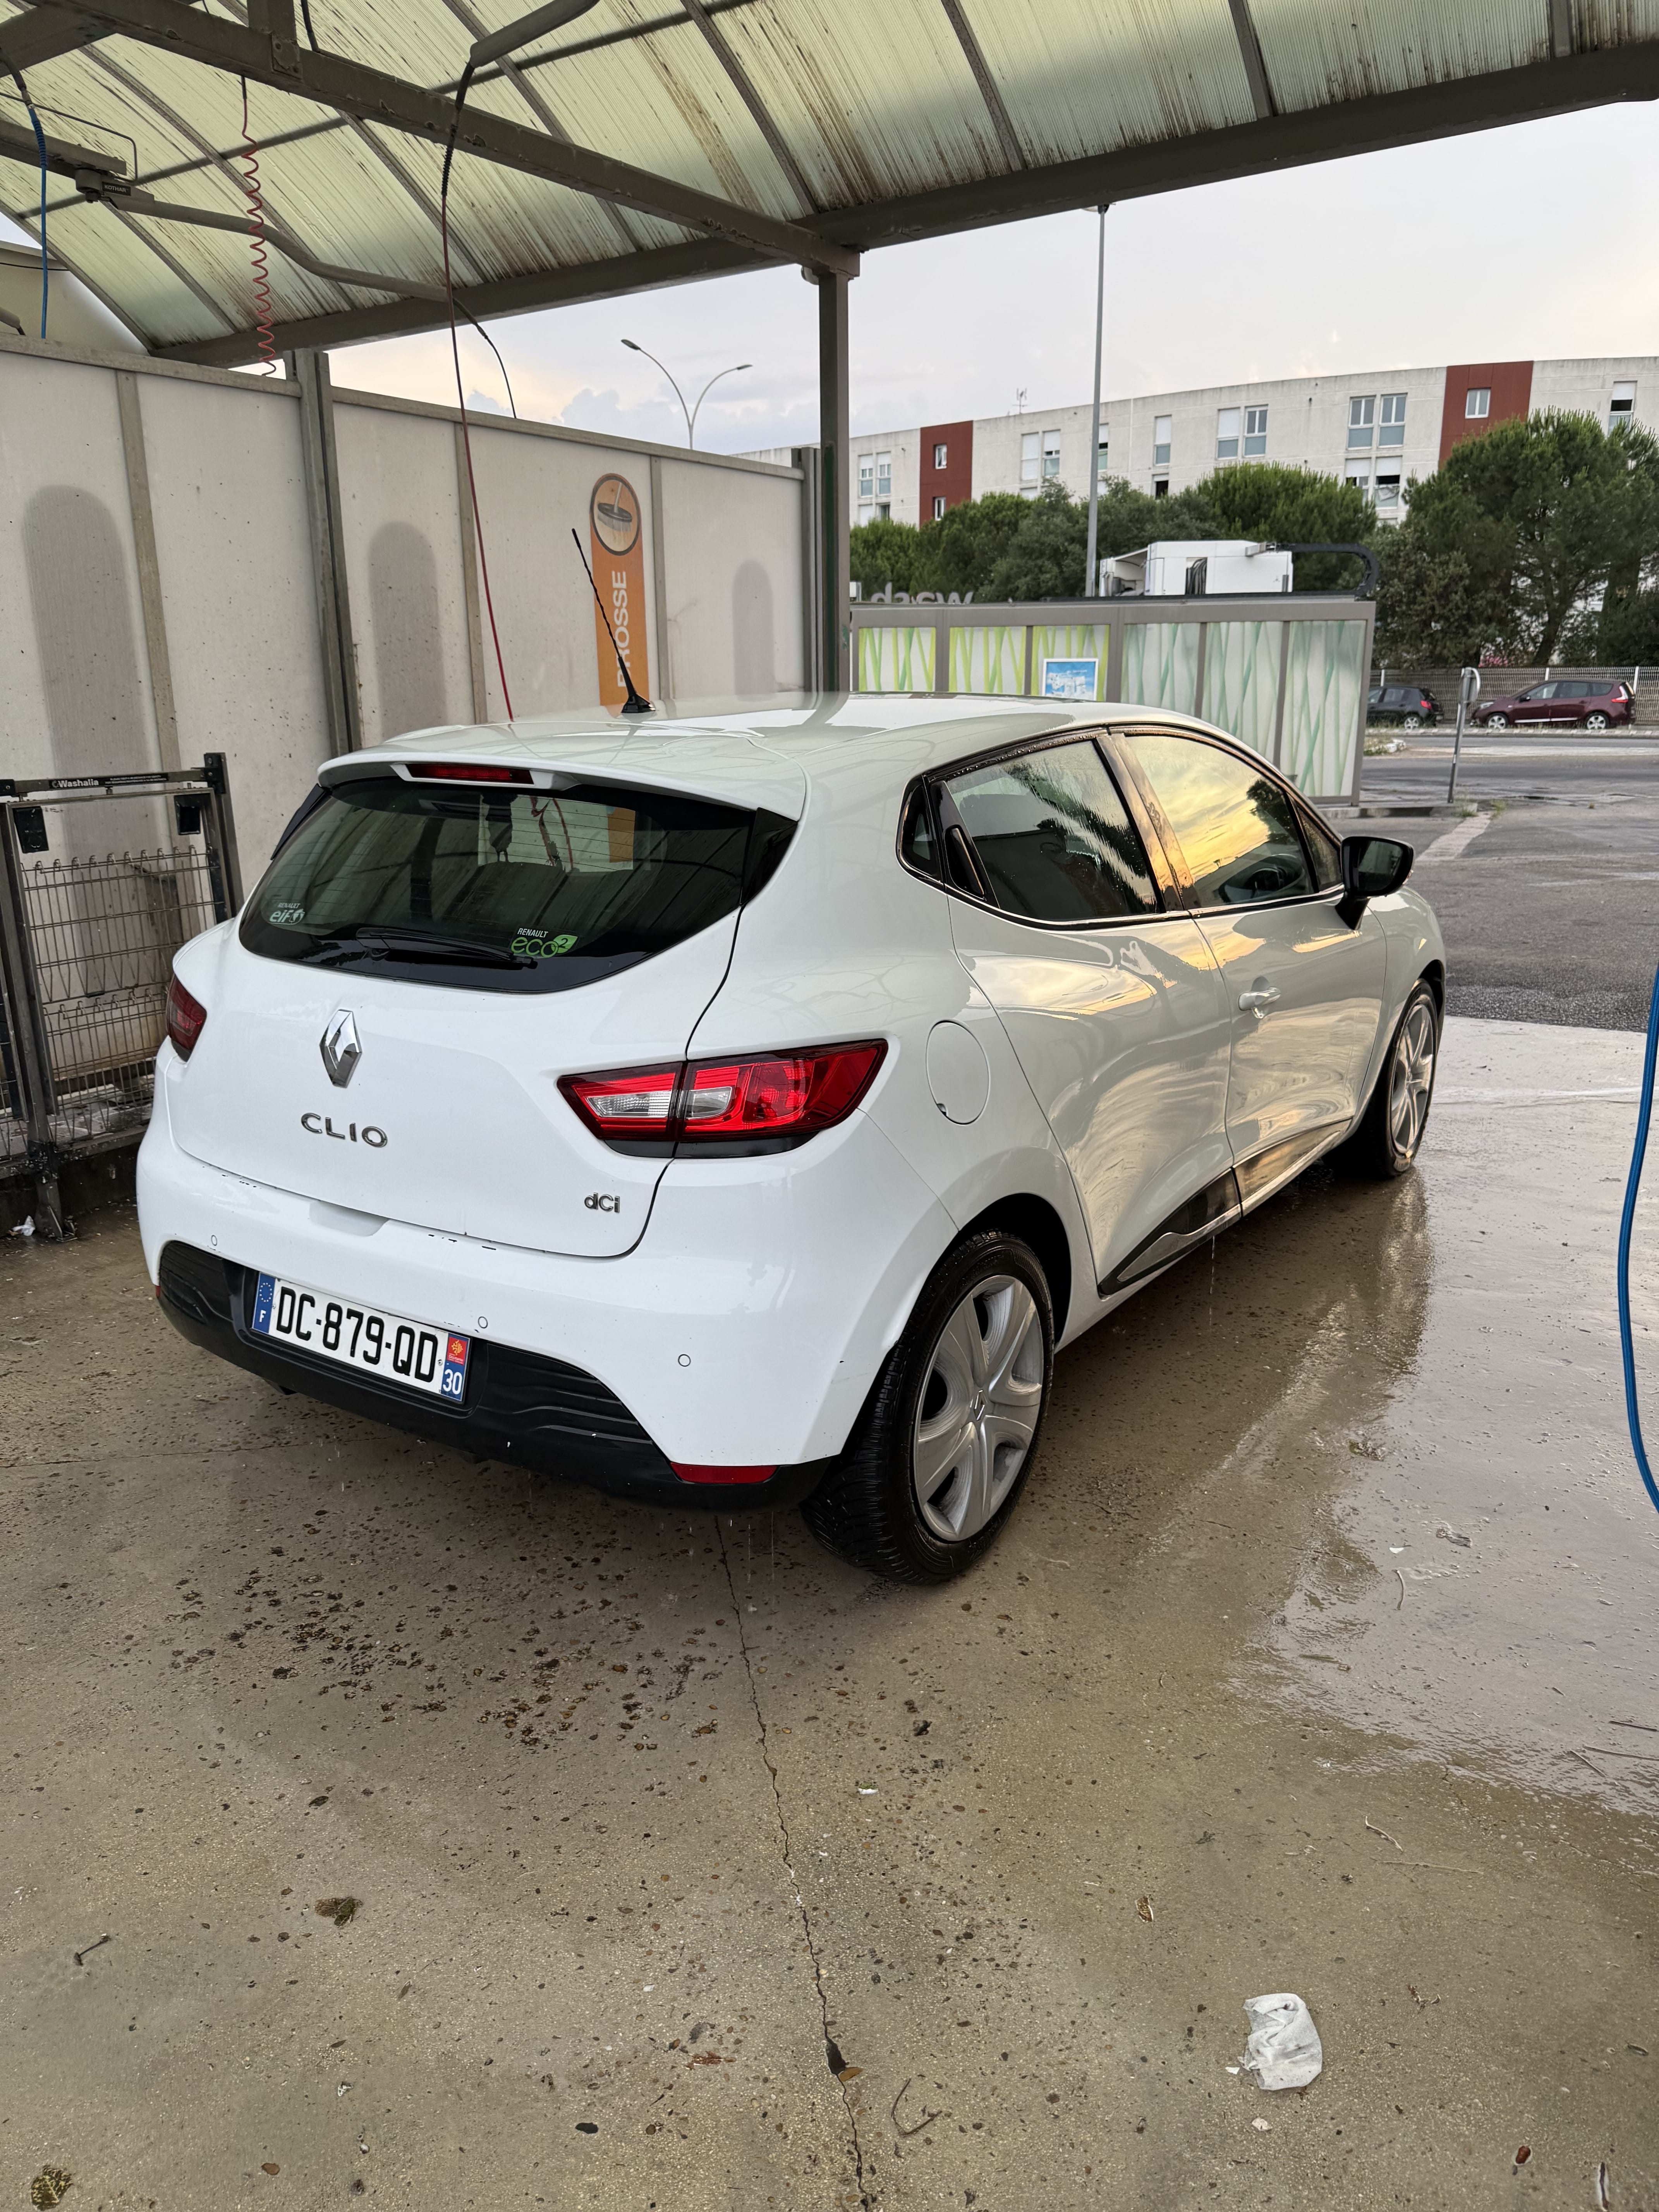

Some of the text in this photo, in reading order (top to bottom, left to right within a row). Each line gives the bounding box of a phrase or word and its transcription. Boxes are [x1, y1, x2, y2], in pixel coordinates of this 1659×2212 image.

[58, 778, 99, 788] Washalia
[517, 927, 549, 938] RENAULT
[301, 1112, 388, 1148] CLIO
[259, 1310, 266, 1323] F
[276, 1286, 438, 1383] DC-879-QD
[443, 1369, 463, 1395] 30
